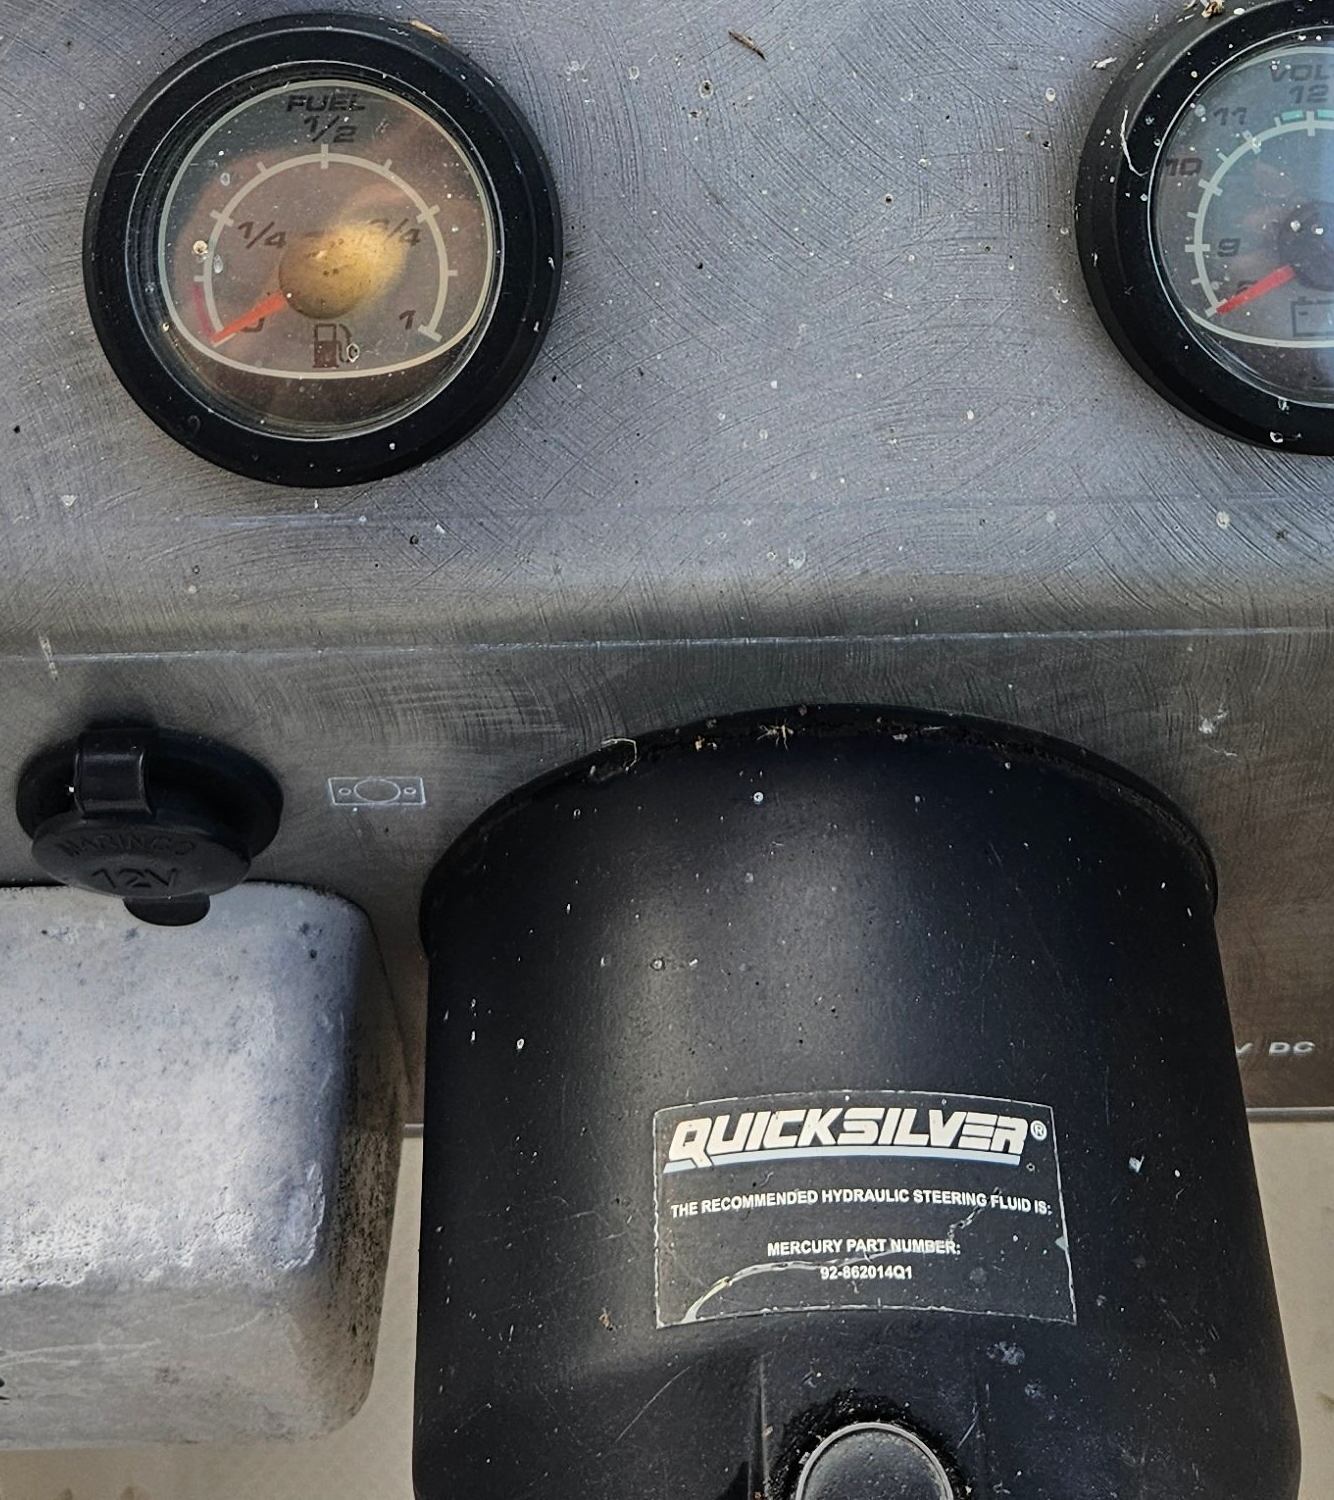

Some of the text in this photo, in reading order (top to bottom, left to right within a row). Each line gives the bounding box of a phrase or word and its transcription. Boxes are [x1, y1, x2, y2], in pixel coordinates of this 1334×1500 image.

[286, 94, 366, 112] FUEL
[1289, 84, 1328, 103] 12
[1214, 107, 1247, 126] 11
[303, 115, 357, 143] 1/2
[1166, 157, 1203, 177] 10
[237, 221, 287, 250] 1/4
[1218, 238, 1241, 257] 9
[399, 309, 417, 330] 1
[55, 833, 196, 858] MARINCO
[92, 866, 178, 890] 12V
[1269, 1041, 1315, 1055] DC
[671, 1187, 1053, 1218] THE RECOMMENDED HYDRAULIC STEERING FLUID IS:
[767, 1238, 961, 1257] MERCURY PART NUMBER:
[820, 1264, 913, 1281] 92-862014Q1
